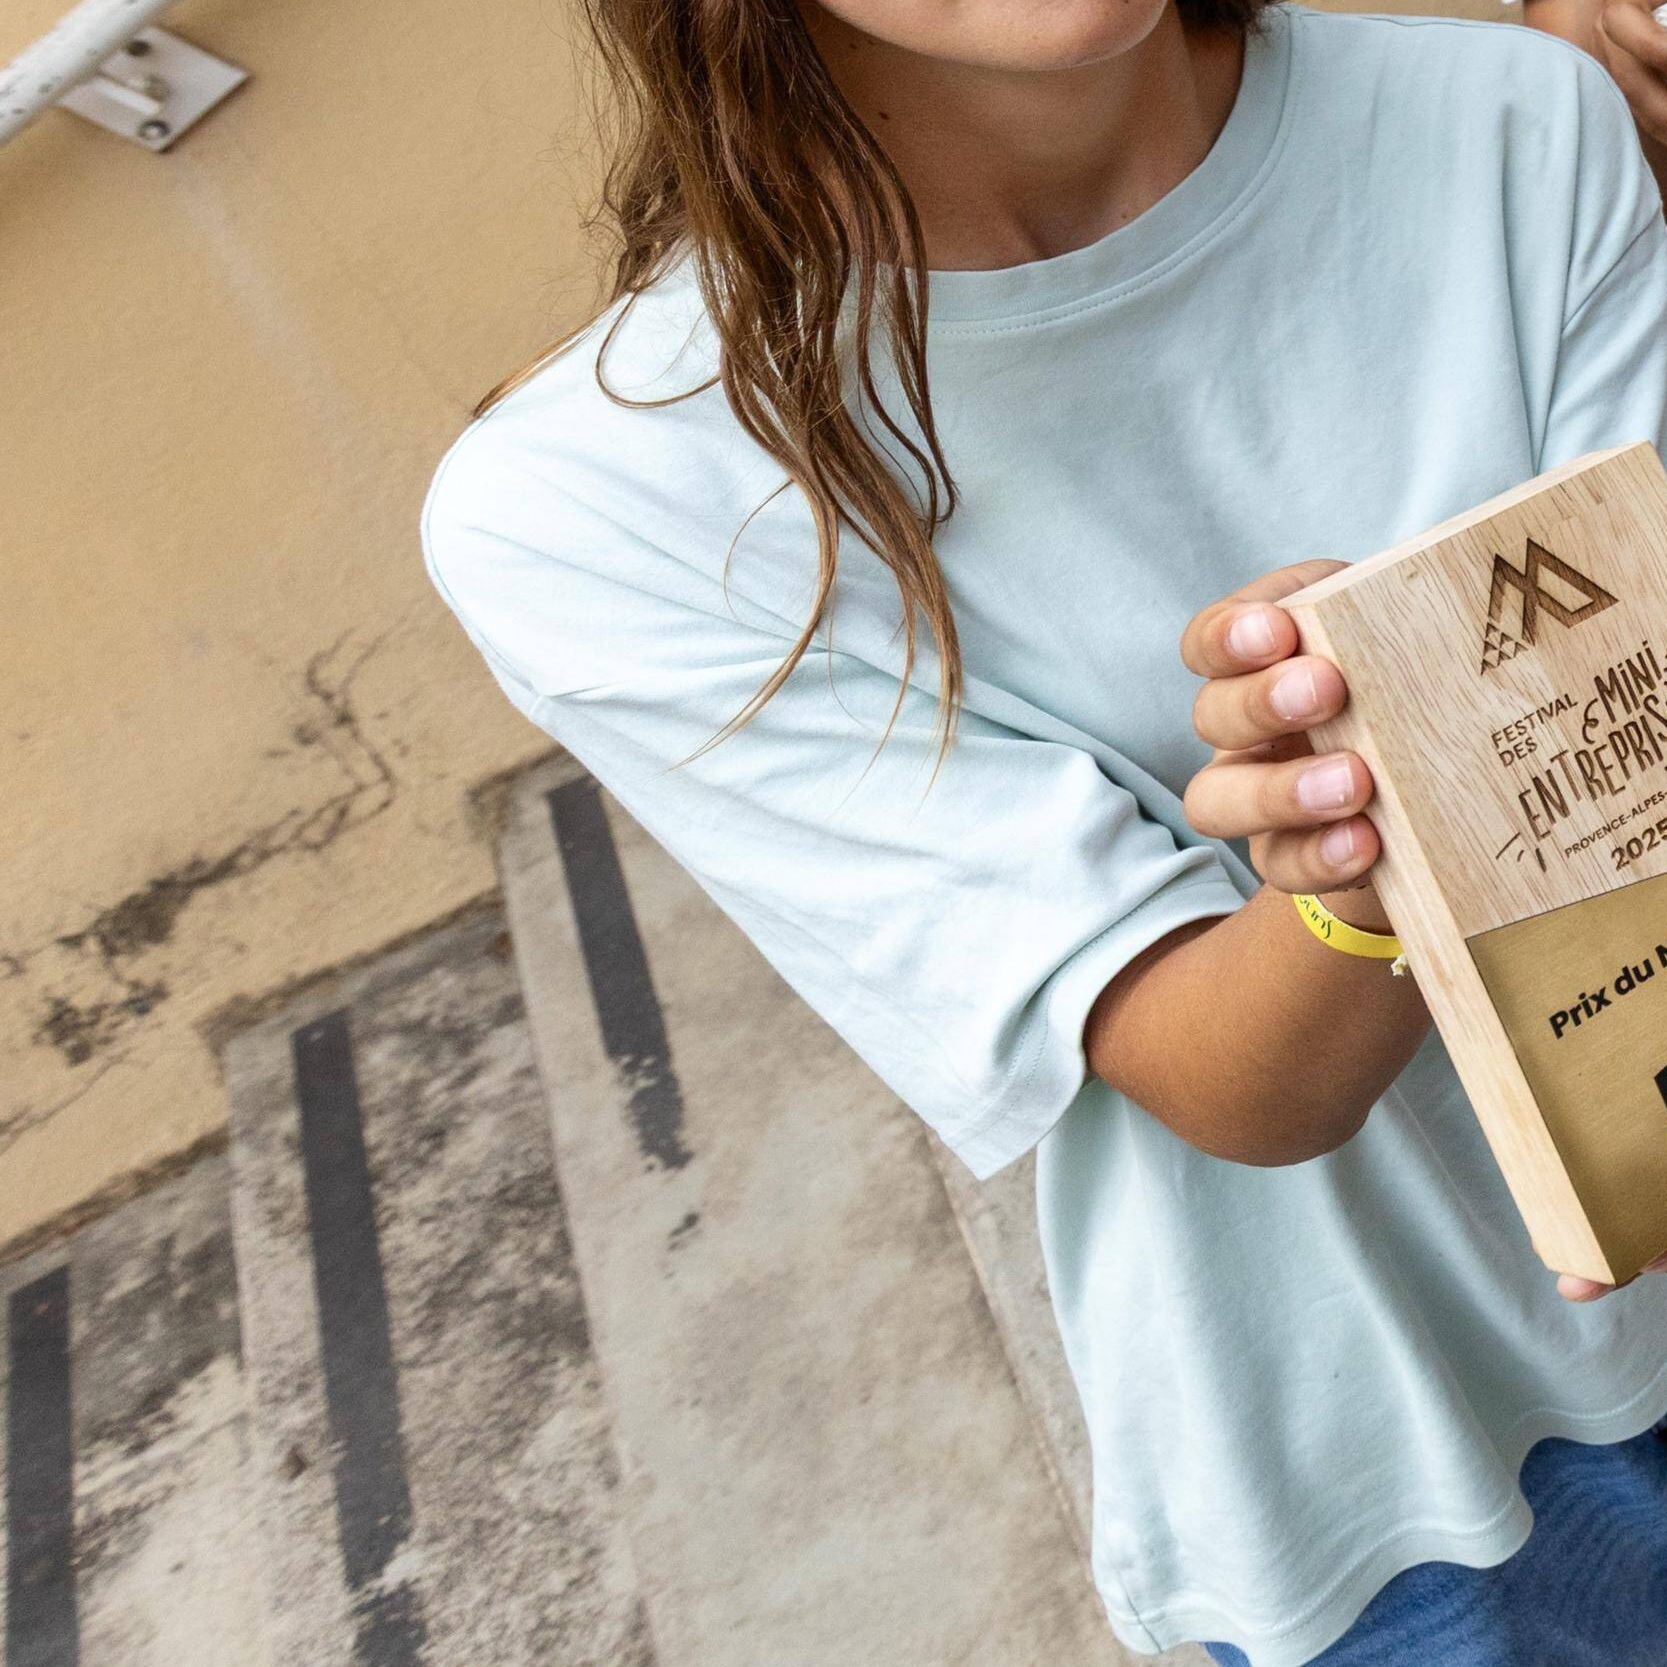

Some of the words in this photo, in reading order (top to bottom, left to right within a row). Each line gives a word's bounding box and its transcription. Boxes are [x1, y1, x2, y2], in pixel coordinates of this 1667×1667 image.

[1491, 693, 1578, 749] FESTIVAL
[1499, 737, 1538, 767] DES
[1549, 986, 1613, 1040] Prix
[1613, 958, 1656, 996] du
